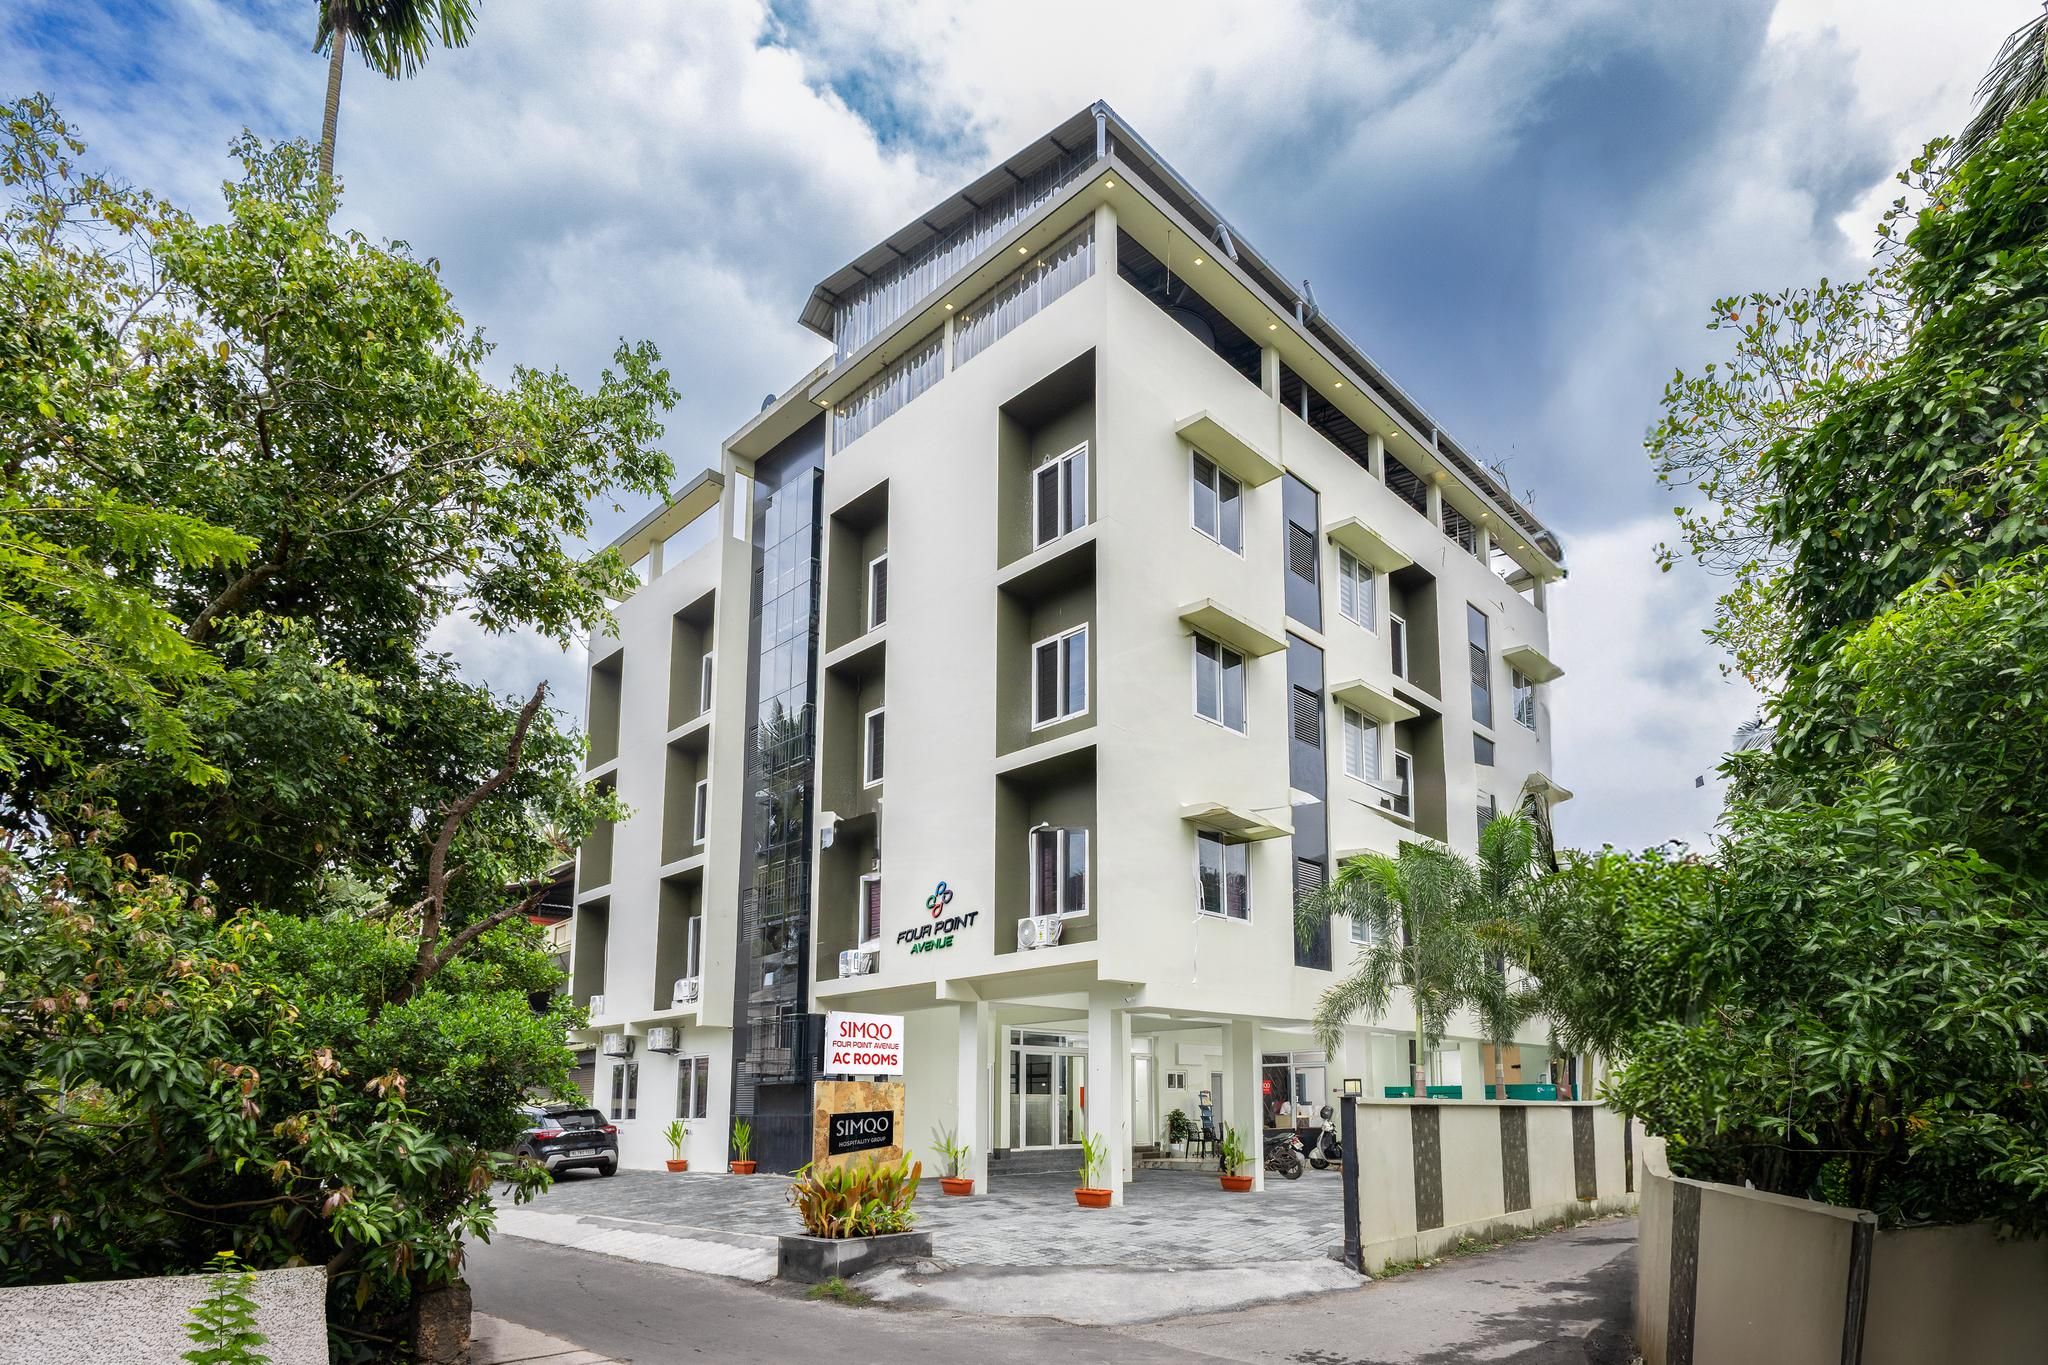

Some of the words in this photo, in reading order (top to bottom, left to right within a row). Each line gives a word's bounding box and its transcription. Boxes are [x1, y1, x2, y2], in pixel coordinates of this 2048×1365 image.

[897, 924, 932, 944] FOUR
[934, 911, 978, 935] POINT
[910, 935, 954, 954] AVENUE
[840, 1021, 892, 1040] SIMQO
[853, 1041, 872, 1049] POINT
[874, 1042, 899, 1050] AVENUE
[832, 1052, 850, 1064] AC
[853, 1053, 898, 1066] ROOMS
[836, 1117, 889, 1136] SIMQO
[838, 1138, 870, 1148] HOSPITALITY
[871, 1135, 886, 1144] GROUP
